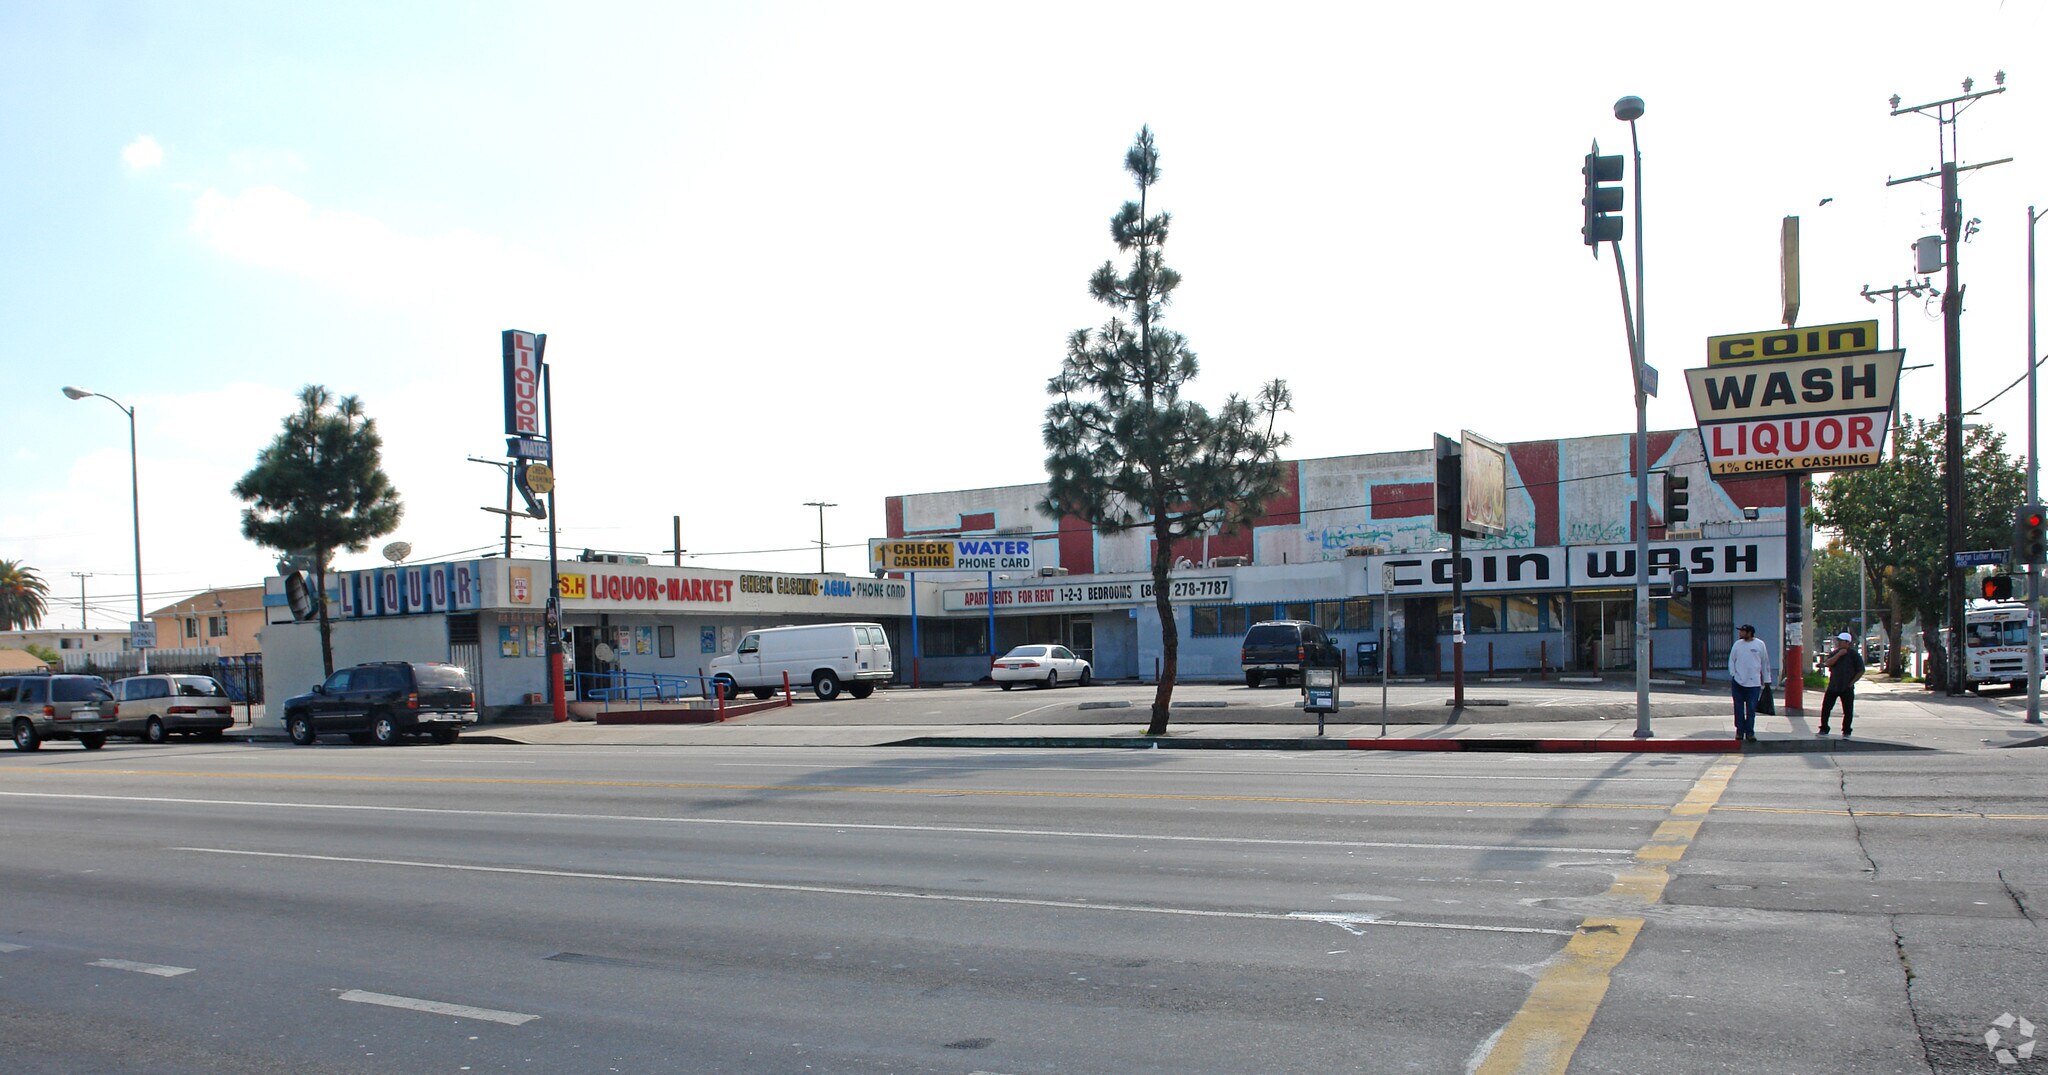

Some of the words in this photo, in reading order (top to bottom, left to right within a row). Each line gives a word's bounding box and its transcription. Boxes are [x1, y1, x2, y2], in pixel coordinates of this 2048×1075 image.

[1718, 327, 1866, 360] COIN
[514, 333, 536, 432] LIQUOR
[1704, 363, 1877, 411] WASH
[1712, 416, 1875, 457] LIQUOR
[520, 440, 548, 458] WATER
[1718, 462, 1740, 473] 1%
[1744, 458, 1794, 471] CHECK
[1801, 453, 1870, 467] CASHING
[893, 543, 948, 555] CHECK
[958, 541, 1030, 555] WATER
[893, 556, 950, 567] CASHING
[958, 558, 995, 568] PHONE
[1001, 557, 1030, 568] CARD
[1586, 545, 1758, 578] WASH
[341, 566, 472, 613] LIQUOR
[740, 575, 774, 593] CHECK
[857, 582, 884, 597] PHONE
[886, 584, 906, 598] CARD
[1018, 589, 1034, 603] FOR
[1035, 589, 1055, 602] RENT
[1060, 588, 1083, 601] 1-2-3
[1088, 585, 1132, 600] BEDROOMS
[1174, 581, 1228, 597] 278-7787
